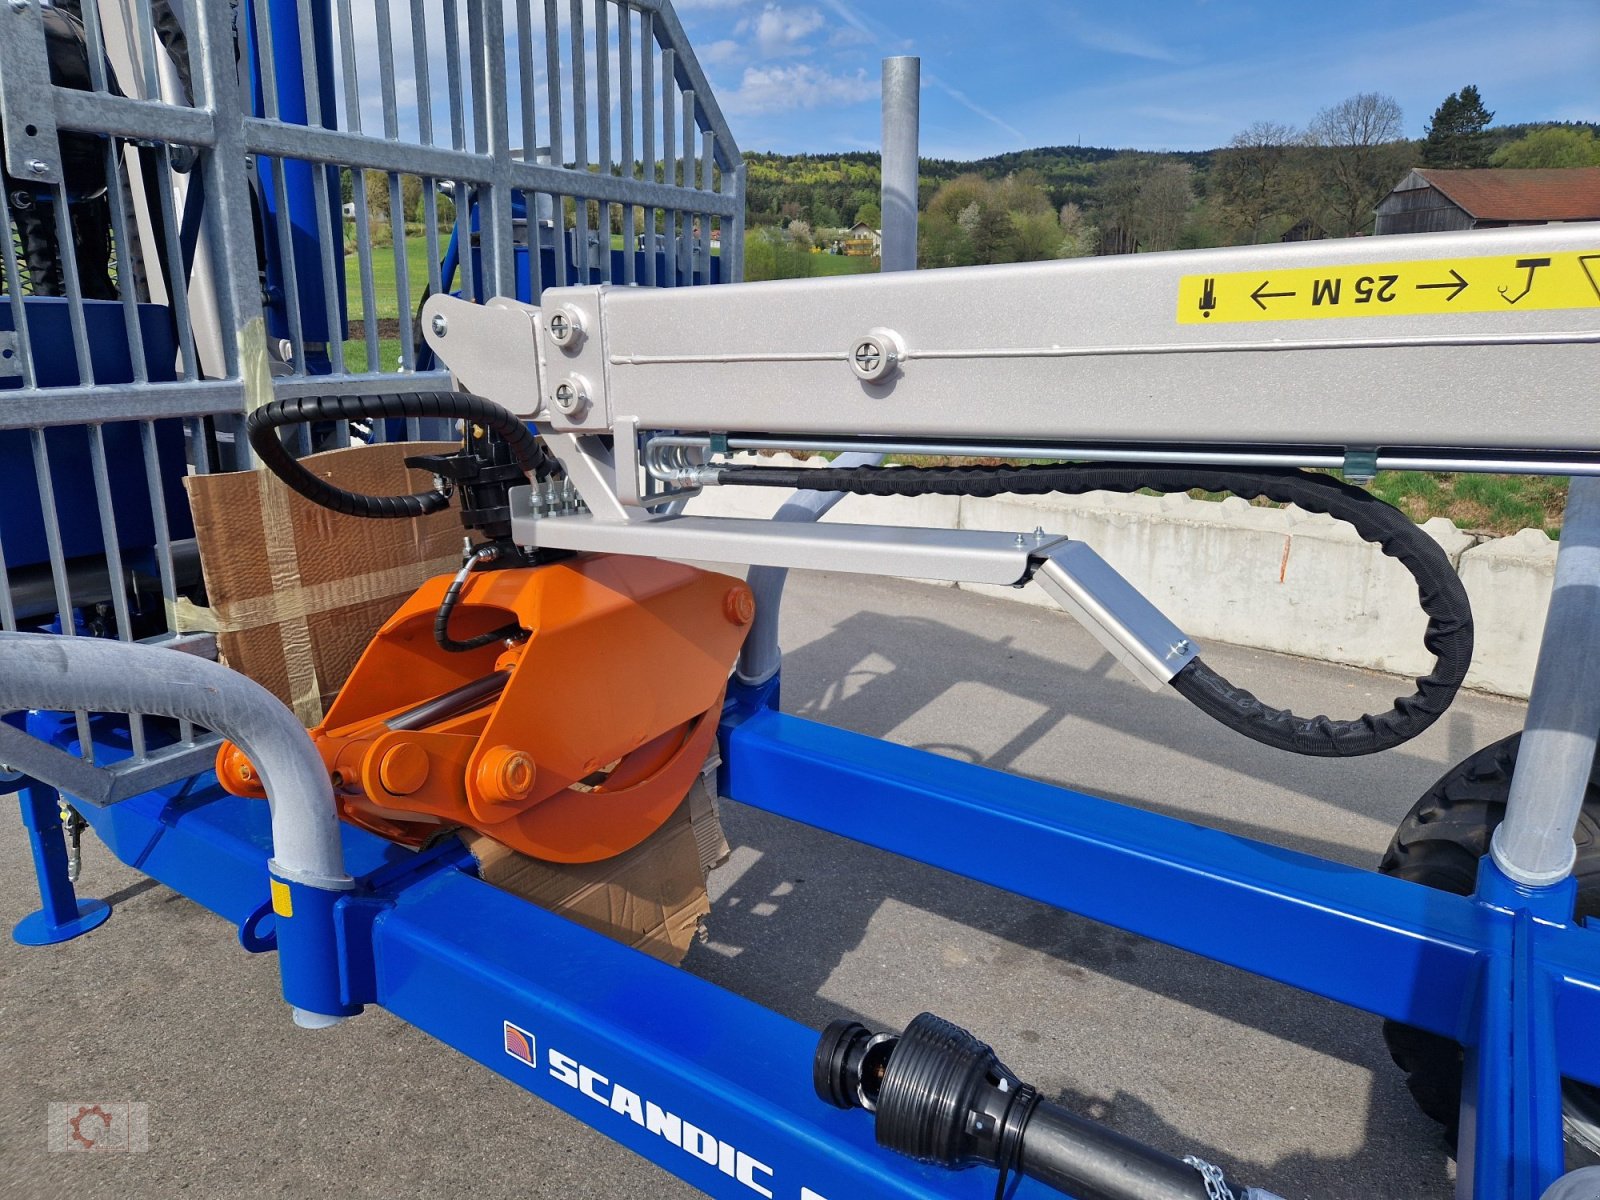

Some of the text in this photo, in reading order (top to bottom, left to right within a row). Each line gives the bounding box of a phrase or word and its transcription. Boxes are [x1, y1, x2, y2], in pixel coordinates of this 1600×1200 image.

[1311, 274, 1399, 306] 25 M
[548, 1048, 774, 1200] SCANDIC
